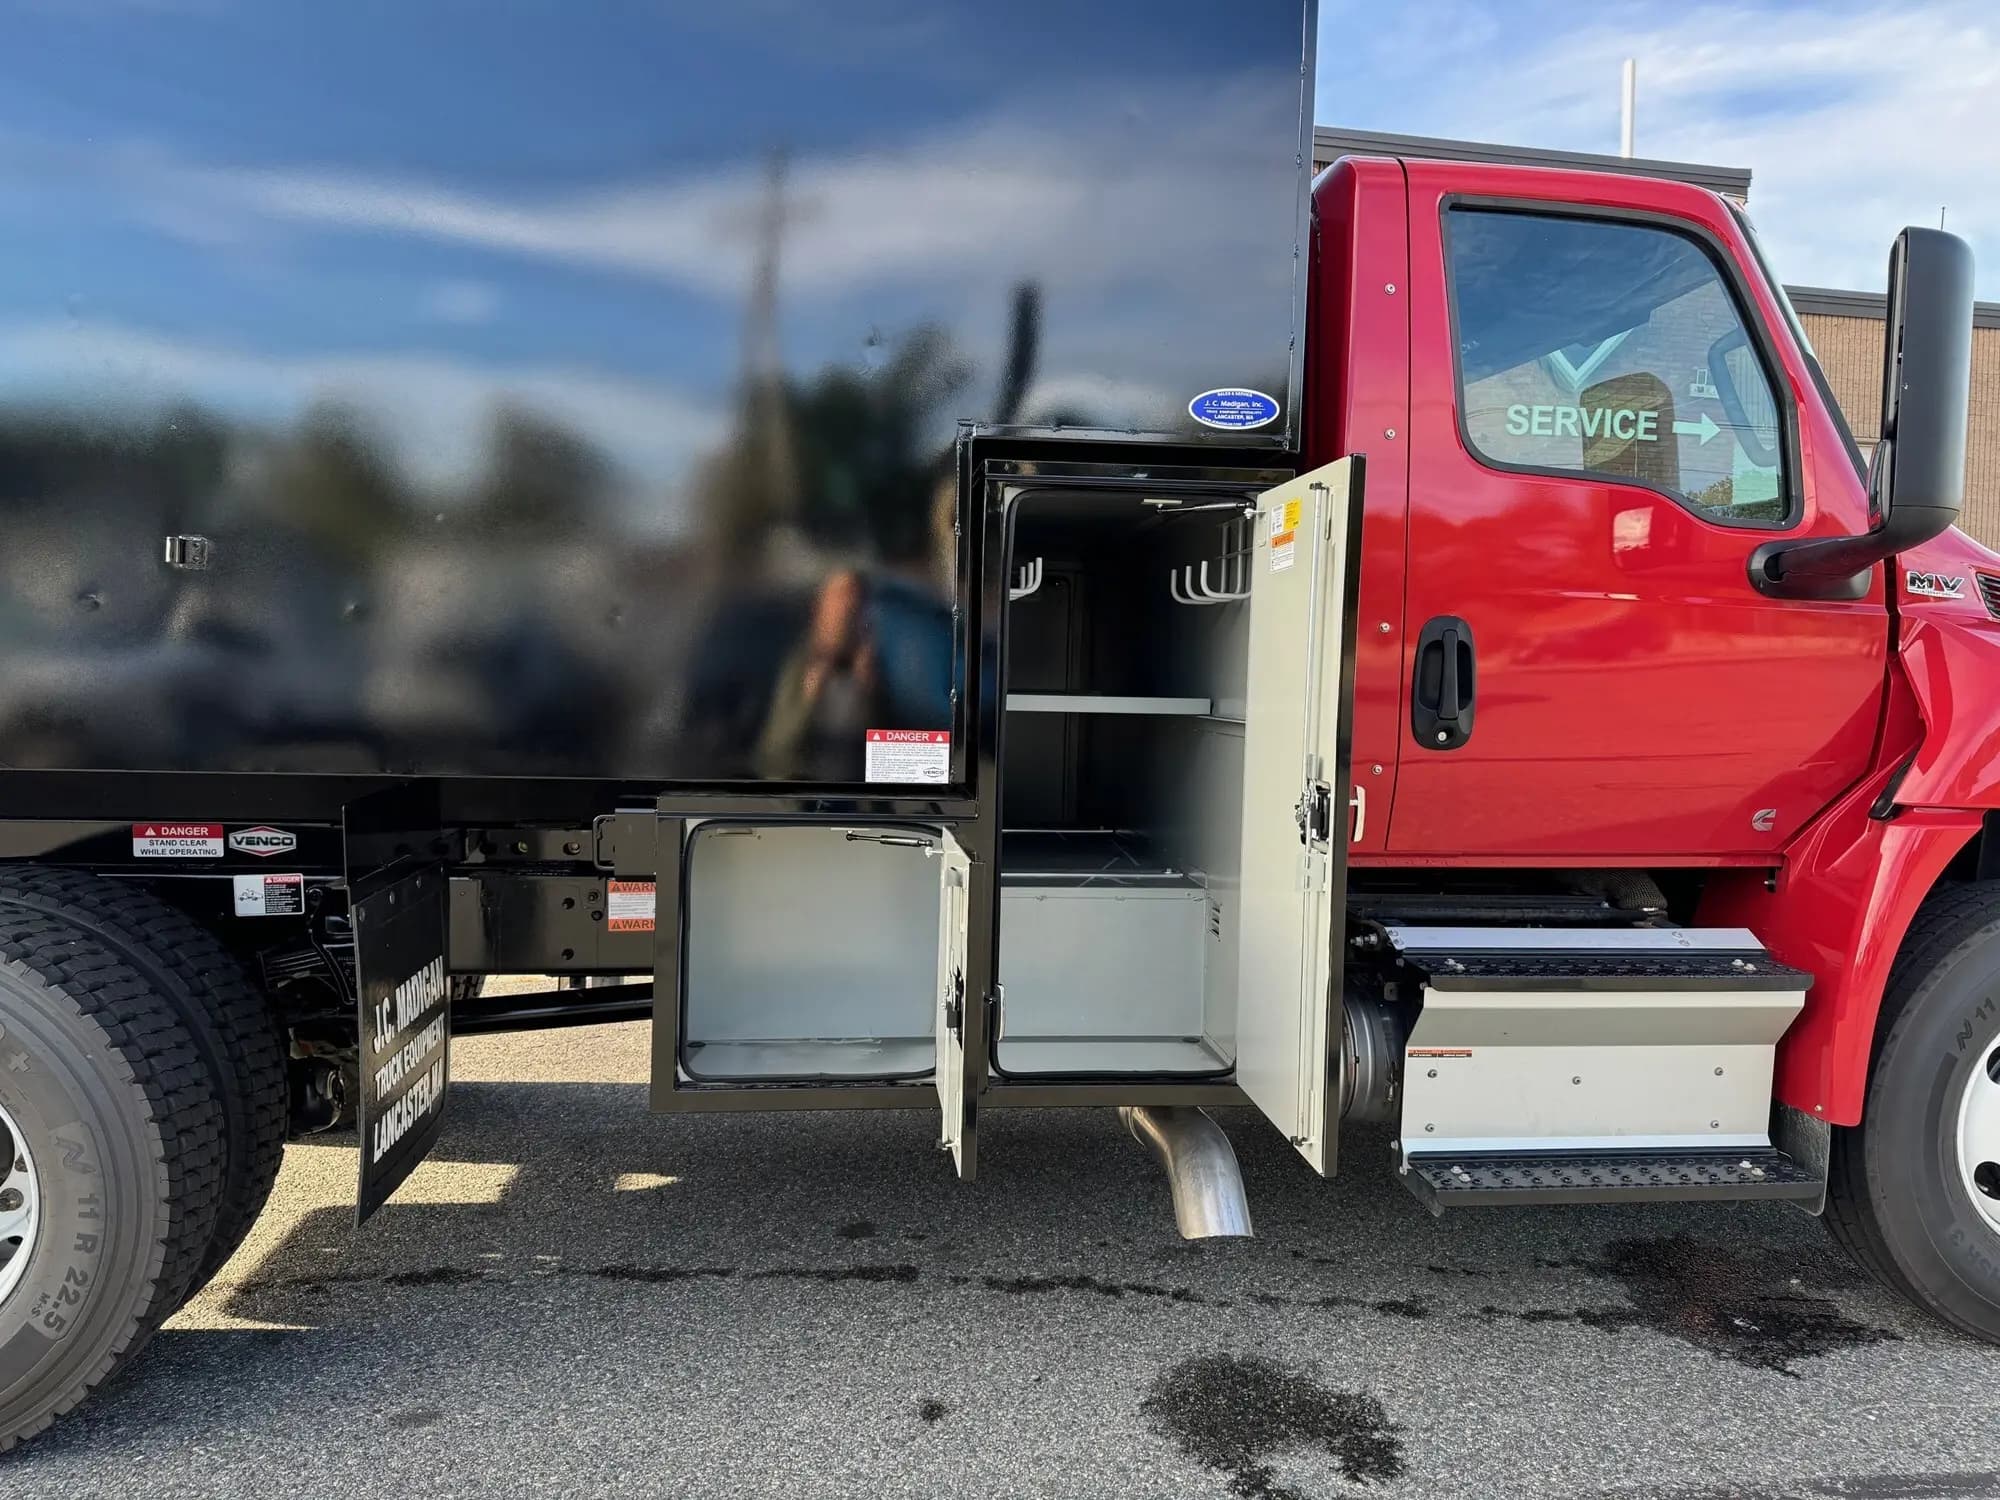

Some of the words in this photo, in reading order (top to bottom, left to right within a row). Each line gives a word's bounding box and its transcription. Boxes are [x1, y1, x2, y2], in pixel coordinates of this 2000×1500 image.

[1505, 404, 1658, 441] SERVICE
[1907, 571, 1964, 593] MV
[886, 732, 930, 742] DANGER
[161, 827, 209, 836] DANGER
[233, 836, 294, 846] VENCO
[373, 997, 395, 1054] J.C.
[395, 955, 444, 1033] MADIGAN
[375, 1050, 401, 1101] TRUCK
[402, 1012, 445, 1077] EQUIPMENT
[74, 1233, 99, 1254] R
[43, 1266, 89, 1332] 22.5
